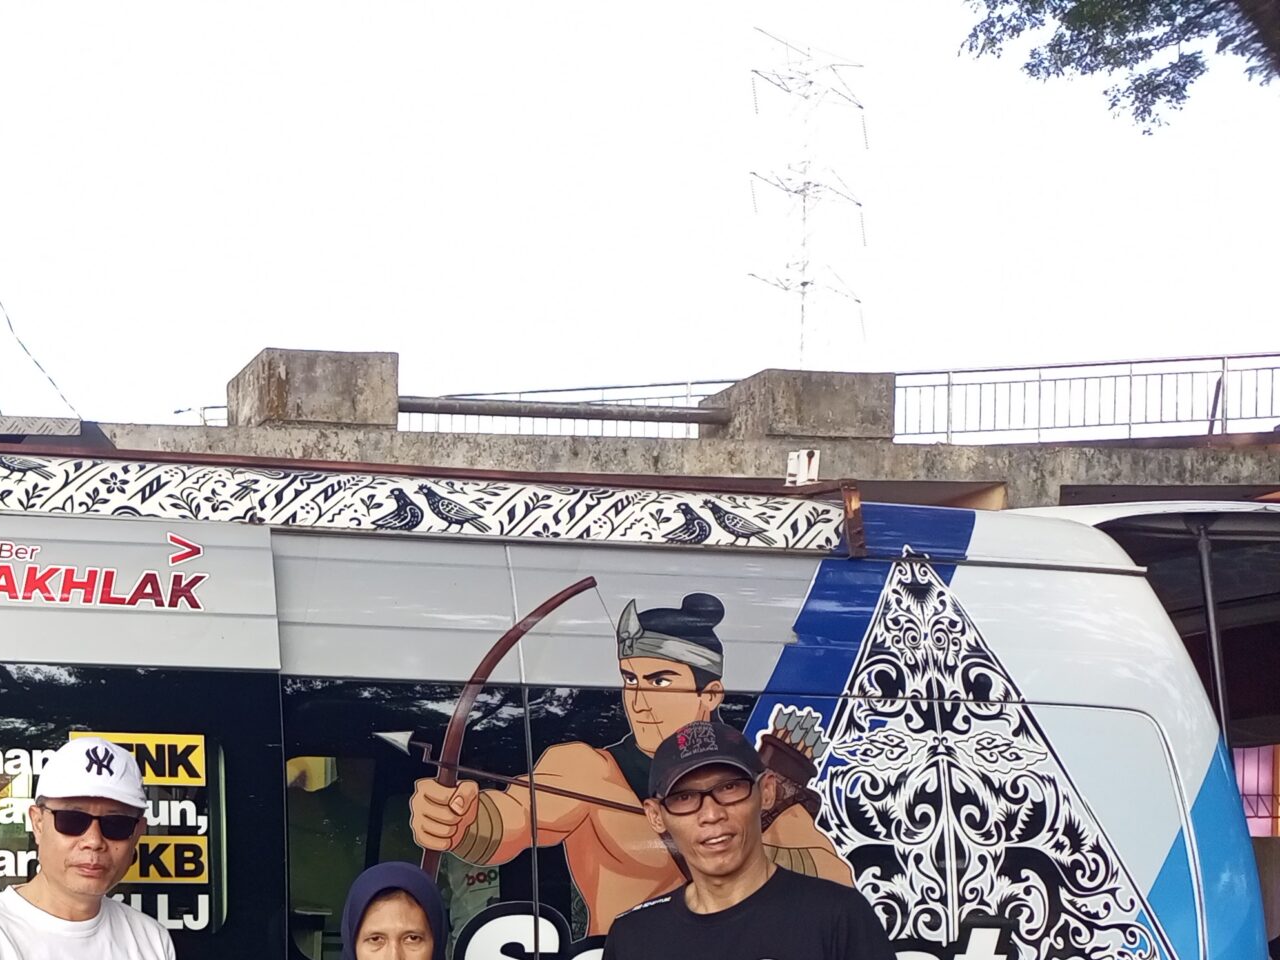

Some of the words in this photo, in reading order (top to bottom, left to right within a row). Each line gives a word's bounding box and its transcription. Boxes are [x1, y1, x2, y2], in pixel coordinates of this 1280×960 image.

[113, 742, 202, 778] NK
[144, 799, 208, 835] un,
[131, 842, 205, 878] KB
